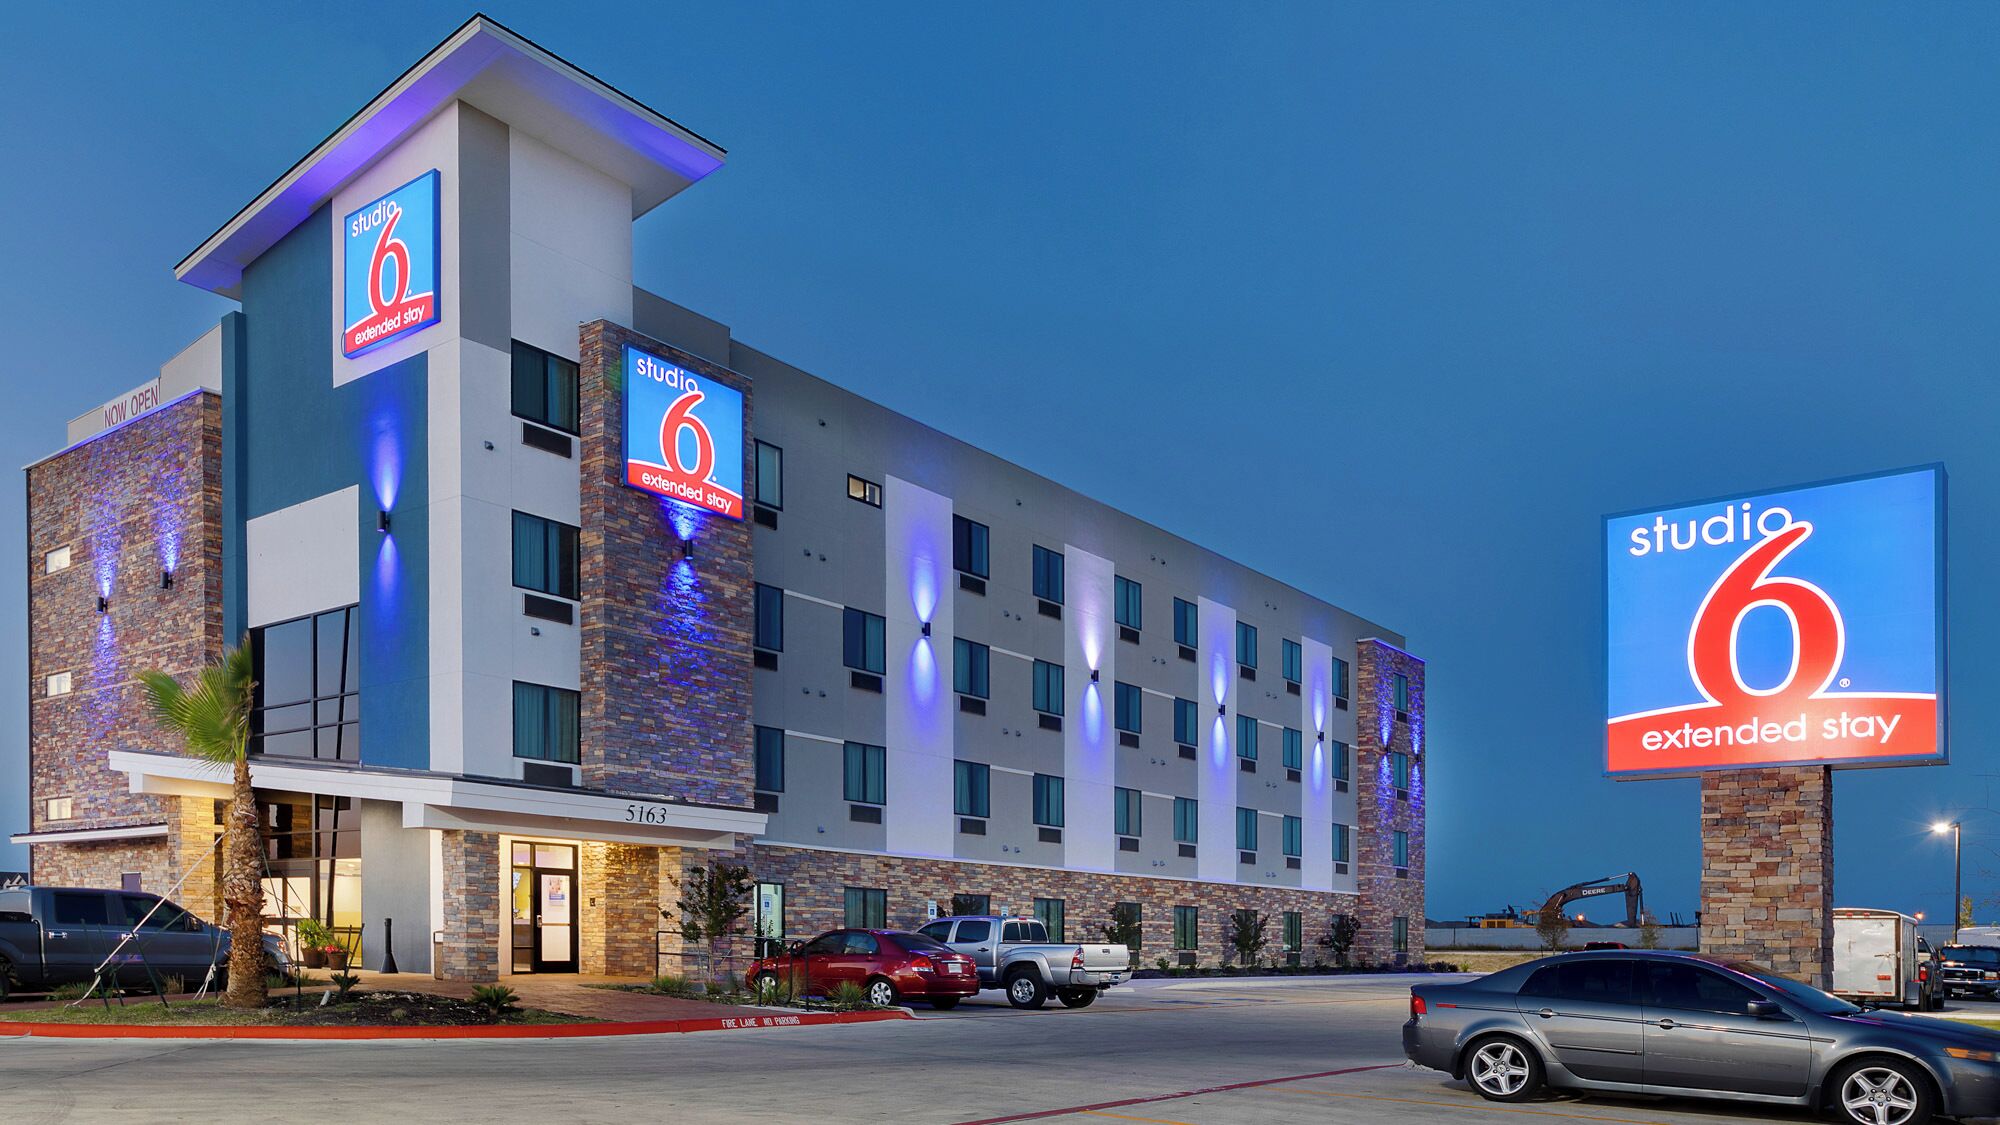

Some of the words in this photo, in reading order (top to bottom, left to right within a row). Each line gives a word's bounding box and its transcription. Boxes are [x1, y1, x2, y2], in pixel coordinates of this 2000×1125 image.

[352, 201, 397, 237] studio
[368, 207, 411, 315] 6
[354, 312, 401, 344] extended
[403, 304, 425, 324] stay
[637, 357, 698, 393] studio
[104, 399, 127, 428] NOW
[130, 384, 158, 417] OPEN
[659, 390, 715, 484] 6
[641, 471, 703, 501] extended
[706, 492, 732, 514] stay
[1629, 502, 1793, 556] studio
[1687, 520, 1845, 707] 6
[1642, 713, 1807, 751] extended
[1822, 711, 1901, 743] stay
[625, 804, 667, 824] 5163
[1582, 888, 1606, 896] DEERE
[721, 1018, 738, 1029] FIRE
[740, 1017, 758, 1028] LANE
[763, 1017, 773, 1026] NO
[775, 1015, 800, 1026] PARKING
